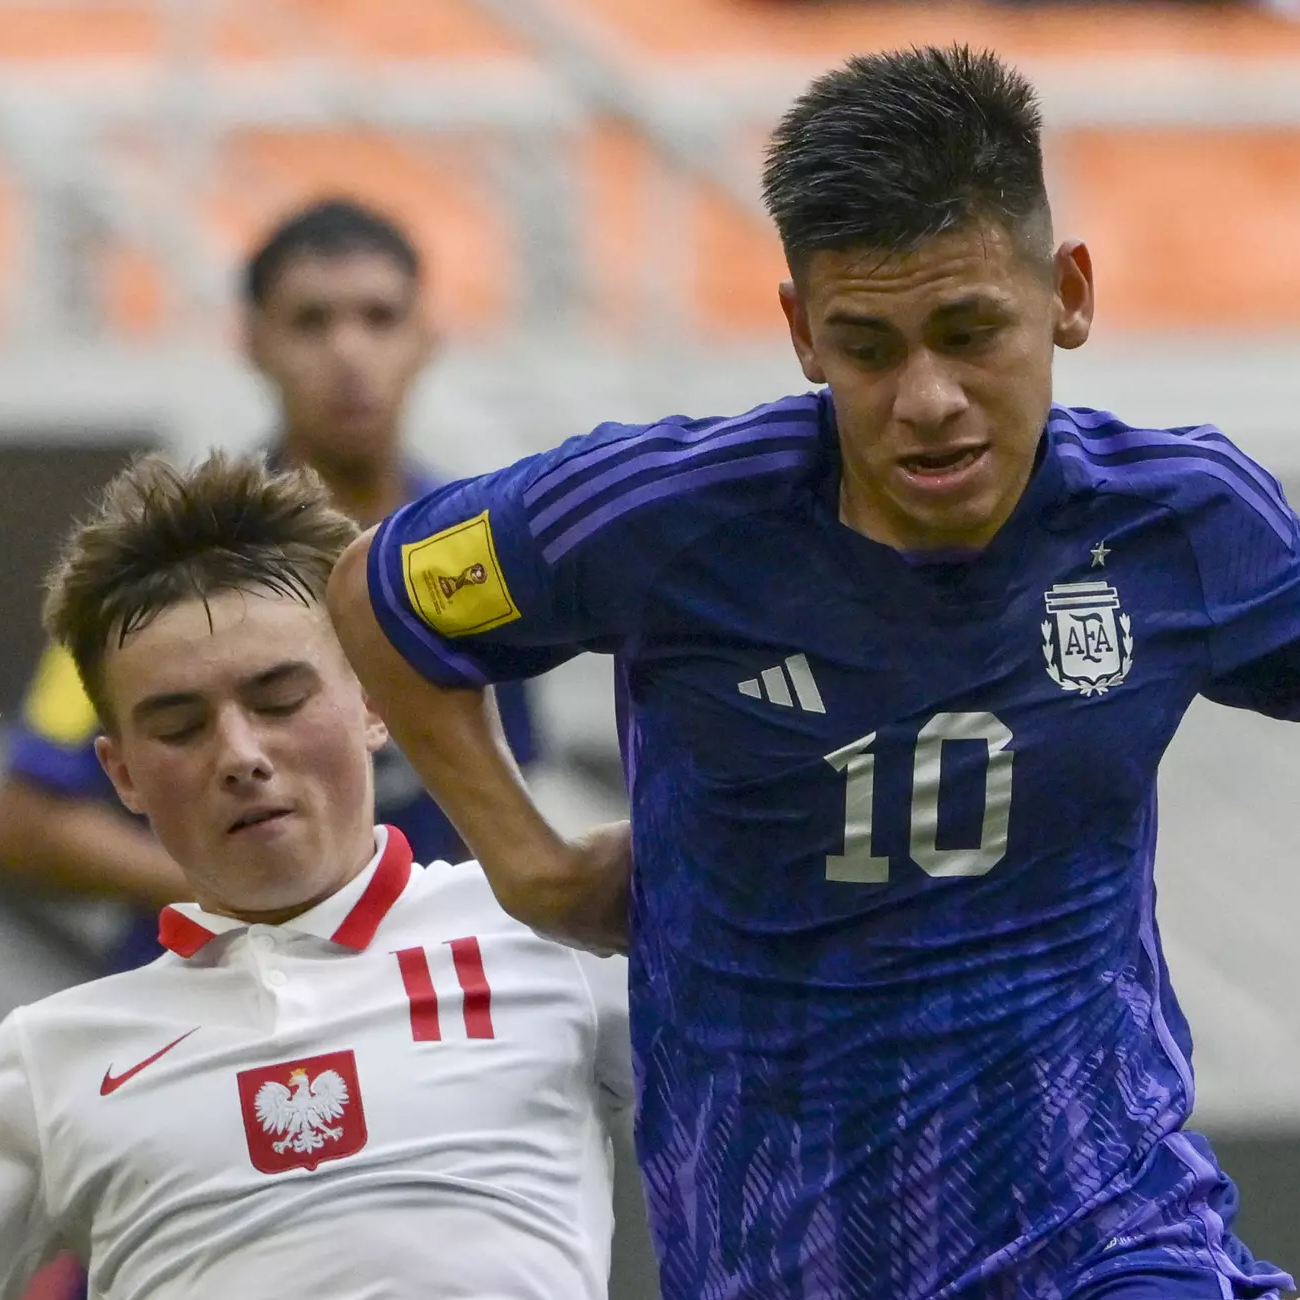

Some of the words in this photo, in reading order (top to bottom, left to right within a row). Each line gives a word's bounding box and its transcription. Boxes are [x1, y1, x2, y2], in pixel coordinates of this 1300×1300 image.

[1064, 612, 1115, 664] AFA
[822, 711, 1014, 883] 10
[388, 935, 495, 1042] 11
